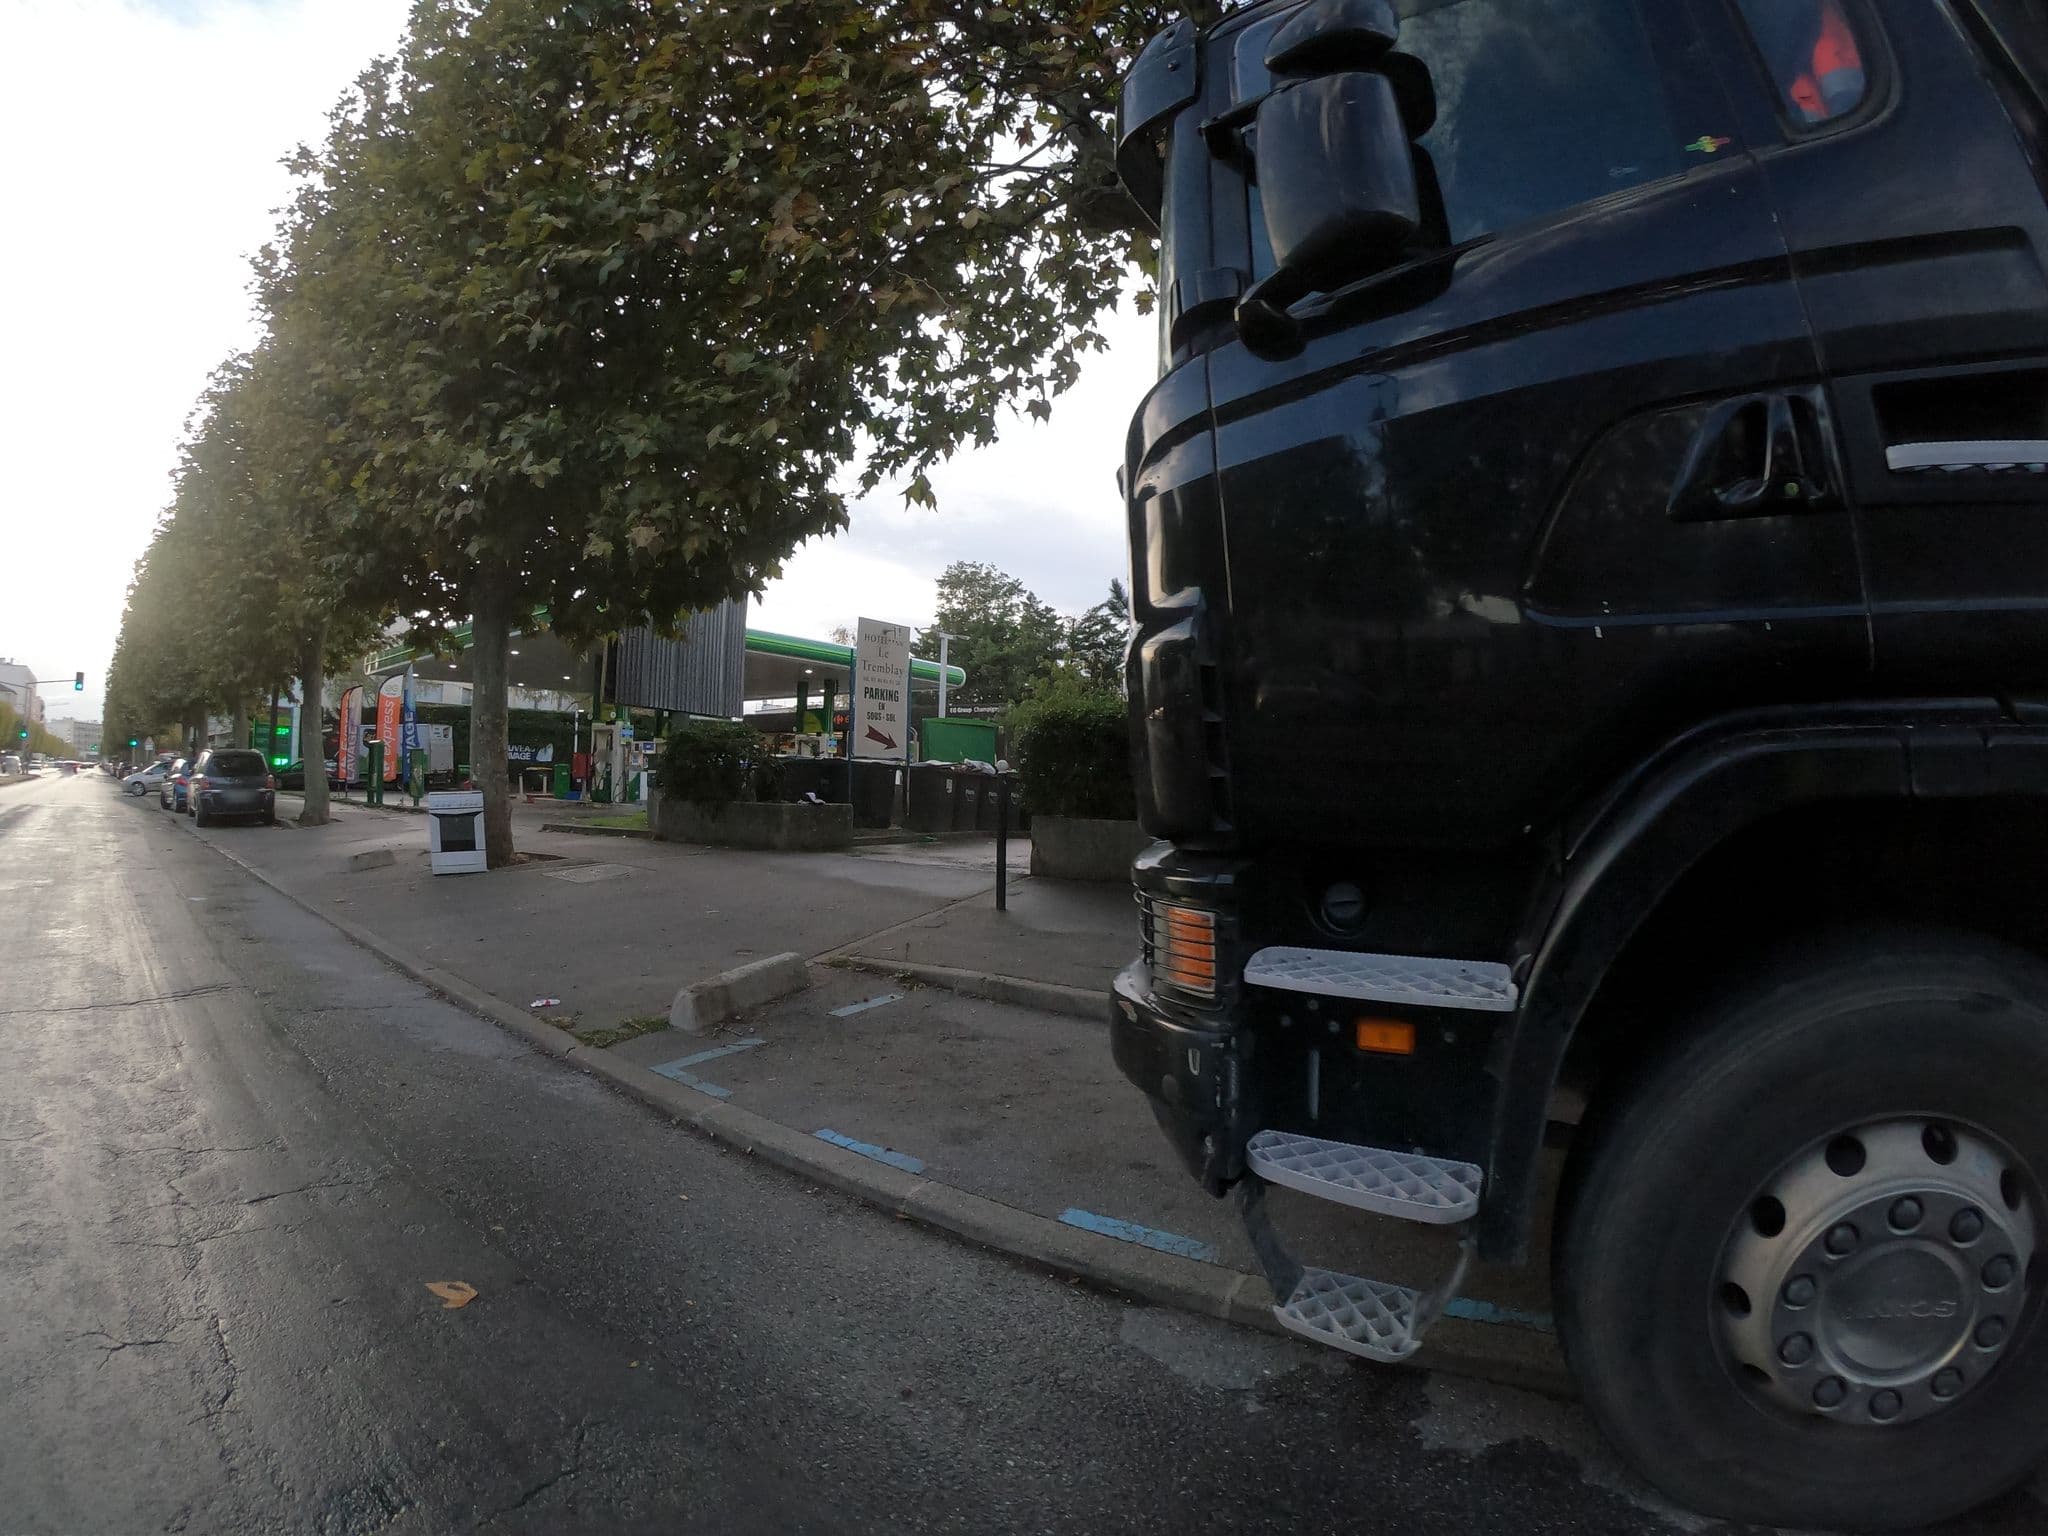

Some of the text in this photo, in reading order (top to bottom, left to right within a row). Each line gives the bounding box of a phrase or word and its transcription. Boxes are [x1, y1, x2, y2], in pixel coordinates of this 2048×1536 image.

[878, 646, 889, 658] Le
[862, 659, 903, 678] Tremblay
[864, 687, 899, 702] PARKING
[878, 702, 885, 711] EN
[383, 700, 396, 756] express
[346, 726, 358, 780] LAVAGE
